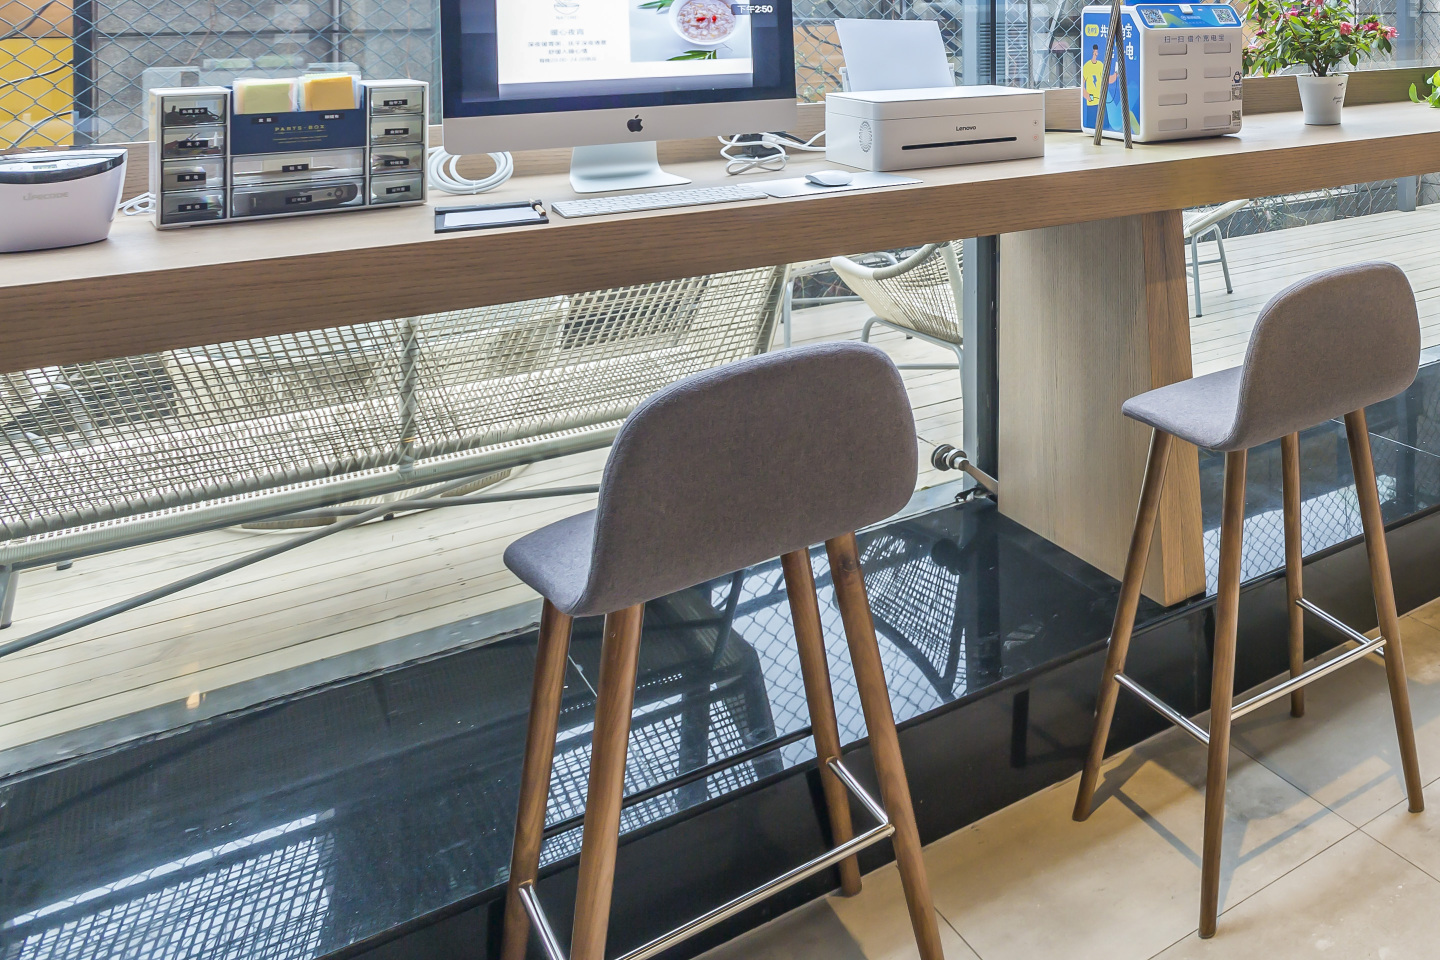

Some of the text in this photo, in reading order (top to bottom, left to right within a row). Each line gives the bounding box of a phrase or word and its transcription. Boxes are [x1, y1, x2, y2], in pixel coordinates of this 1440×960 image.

[737, 5, 774, 14] 下午2:50
[1164, 34, 1225, 44] 扫一扫 借个充电宝
